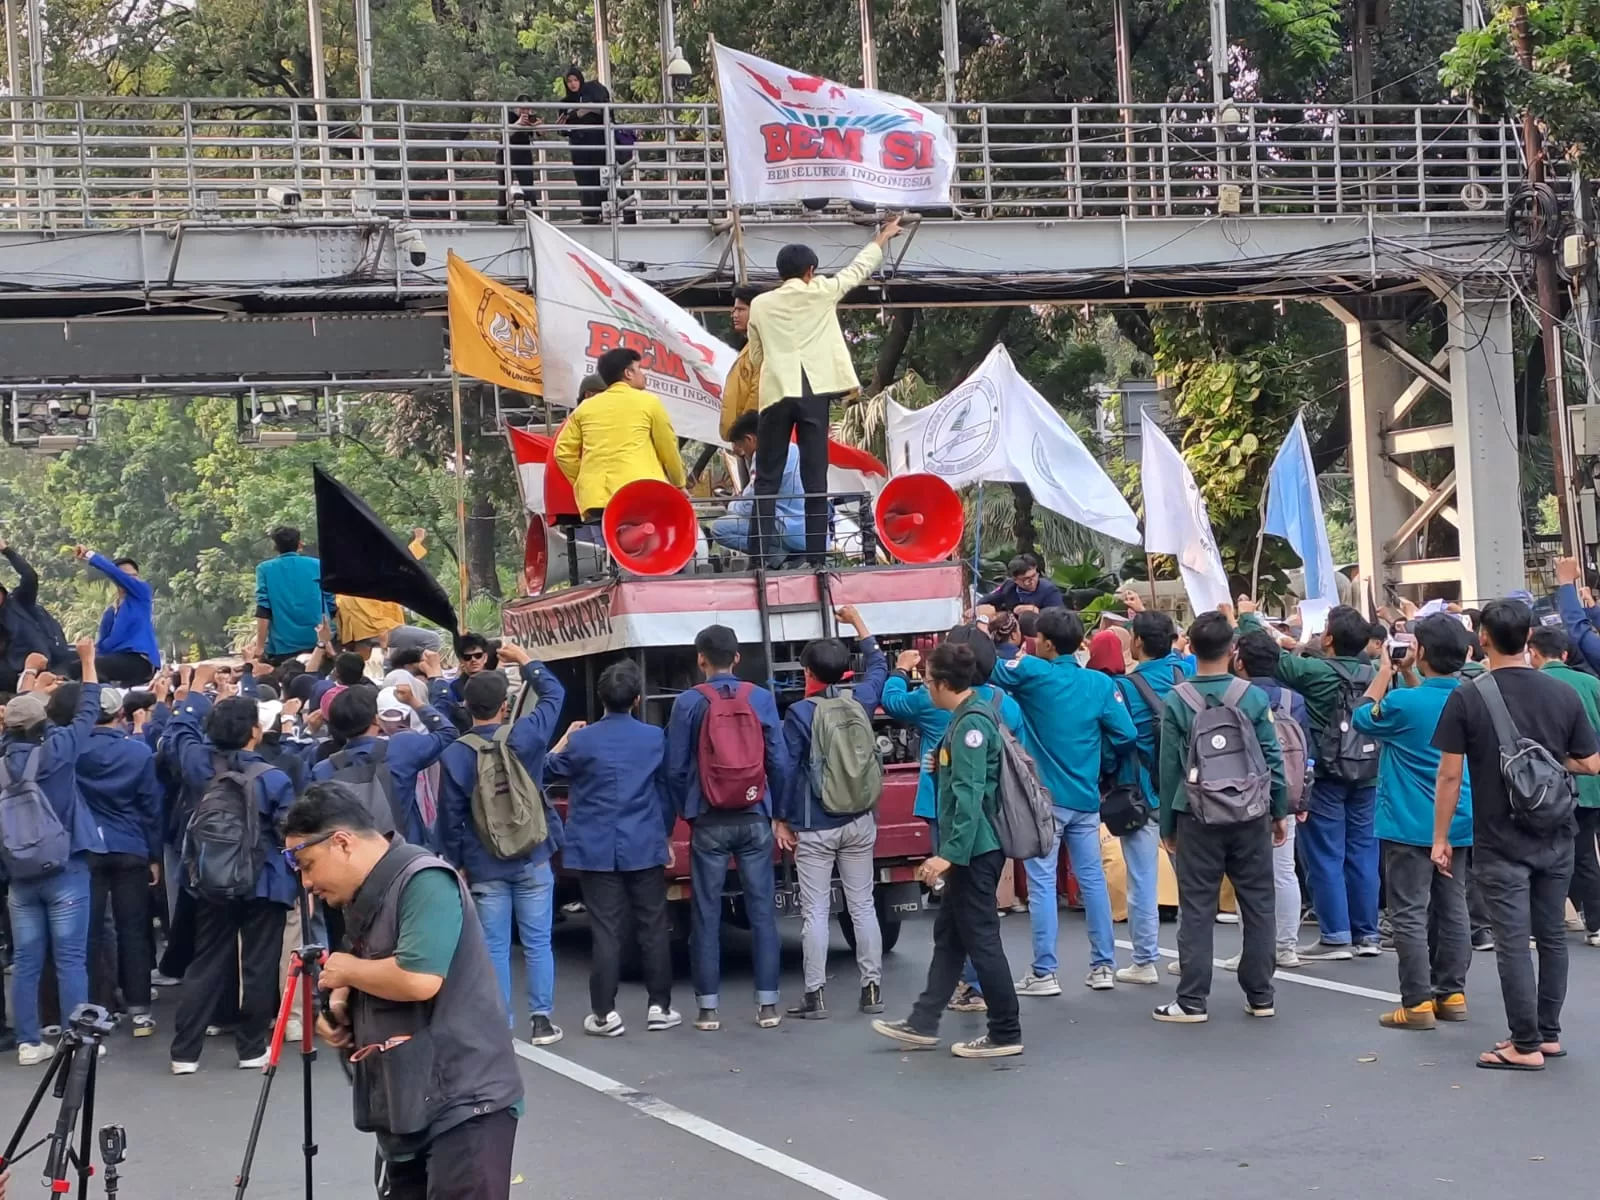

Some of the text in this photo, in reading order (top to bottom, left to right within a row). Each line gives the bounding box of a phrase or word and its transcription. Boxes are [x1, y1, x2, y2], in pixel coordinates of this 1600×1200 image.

[760, 122, 936, 170] BEM SI
[852, 167, 932, 188] INDONESIA
[585, 320, 690, 383] BEM
[511, 594, 613, 649] SUARA RAKYAT
